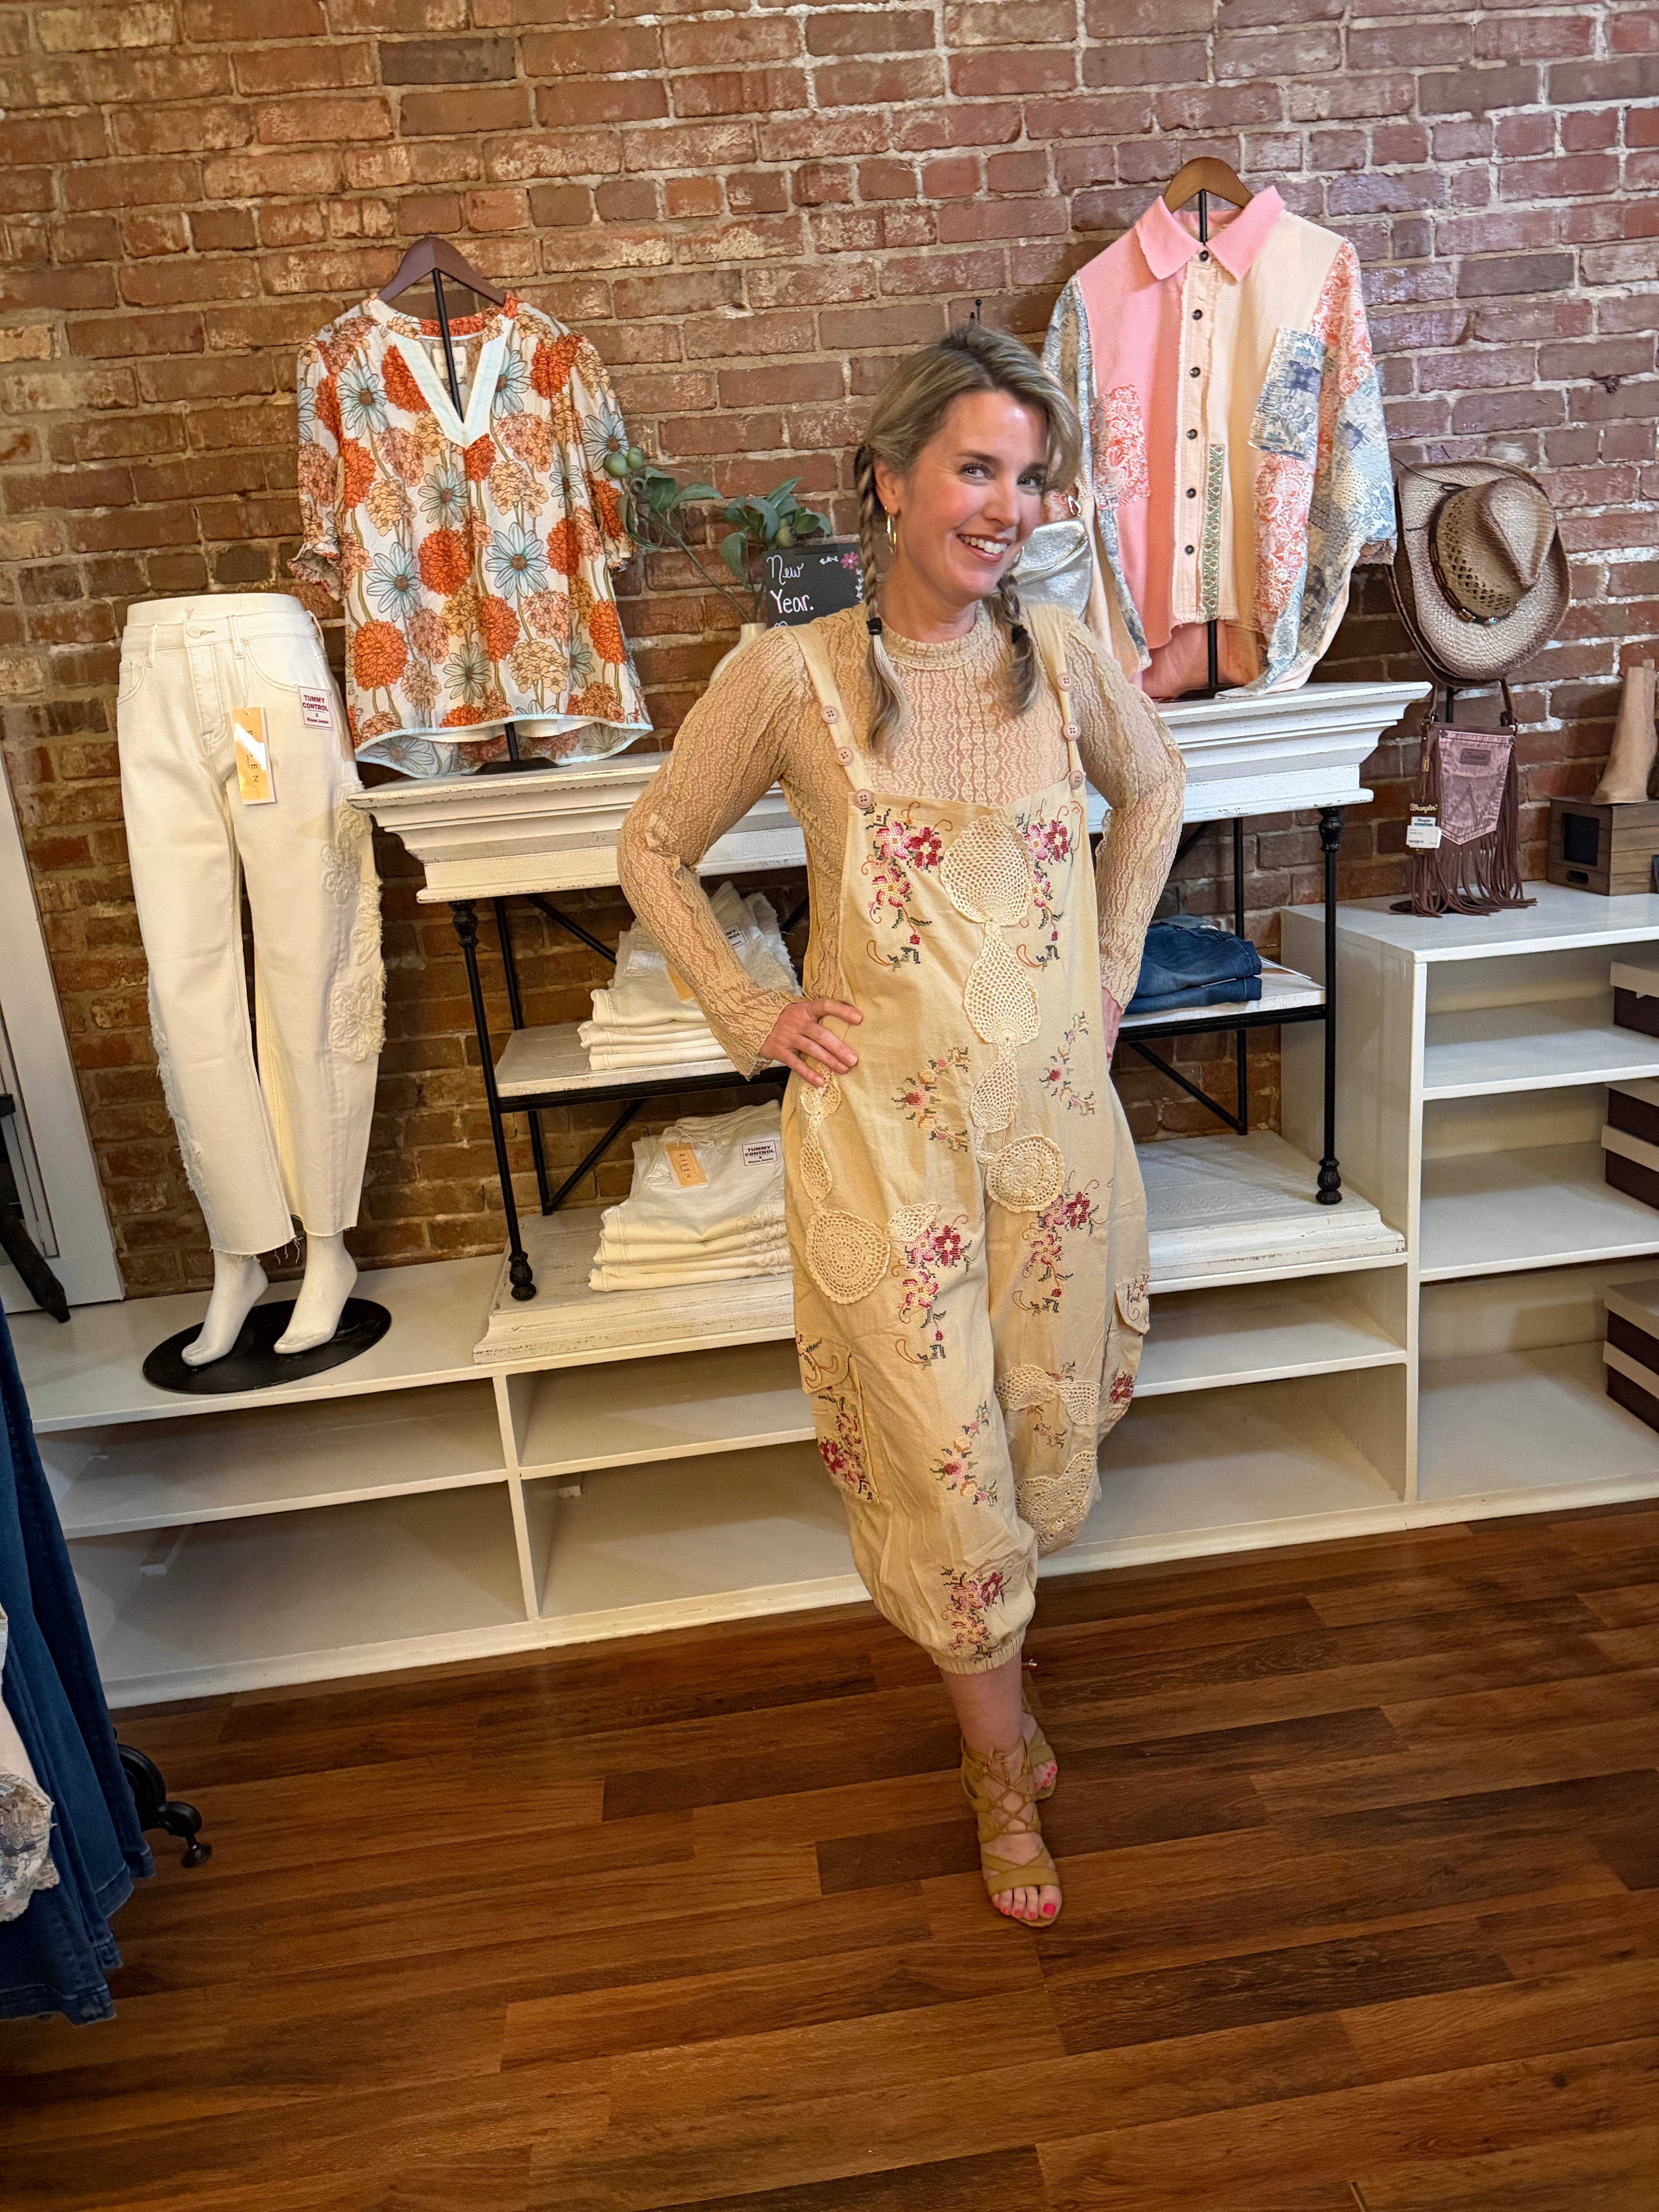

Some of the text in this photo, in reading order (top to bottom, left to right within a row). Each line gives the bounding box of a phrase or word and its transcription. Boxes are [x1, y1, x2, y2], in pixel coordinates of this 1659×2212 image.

[766, 555, 804, 586] New
[769, 589, 814, 613] Year.
[302, 702, 329, 711] CONTROL
[304, 695, 325, 703] TUMMY
[679, 1154, 690, 1178] RISEN
